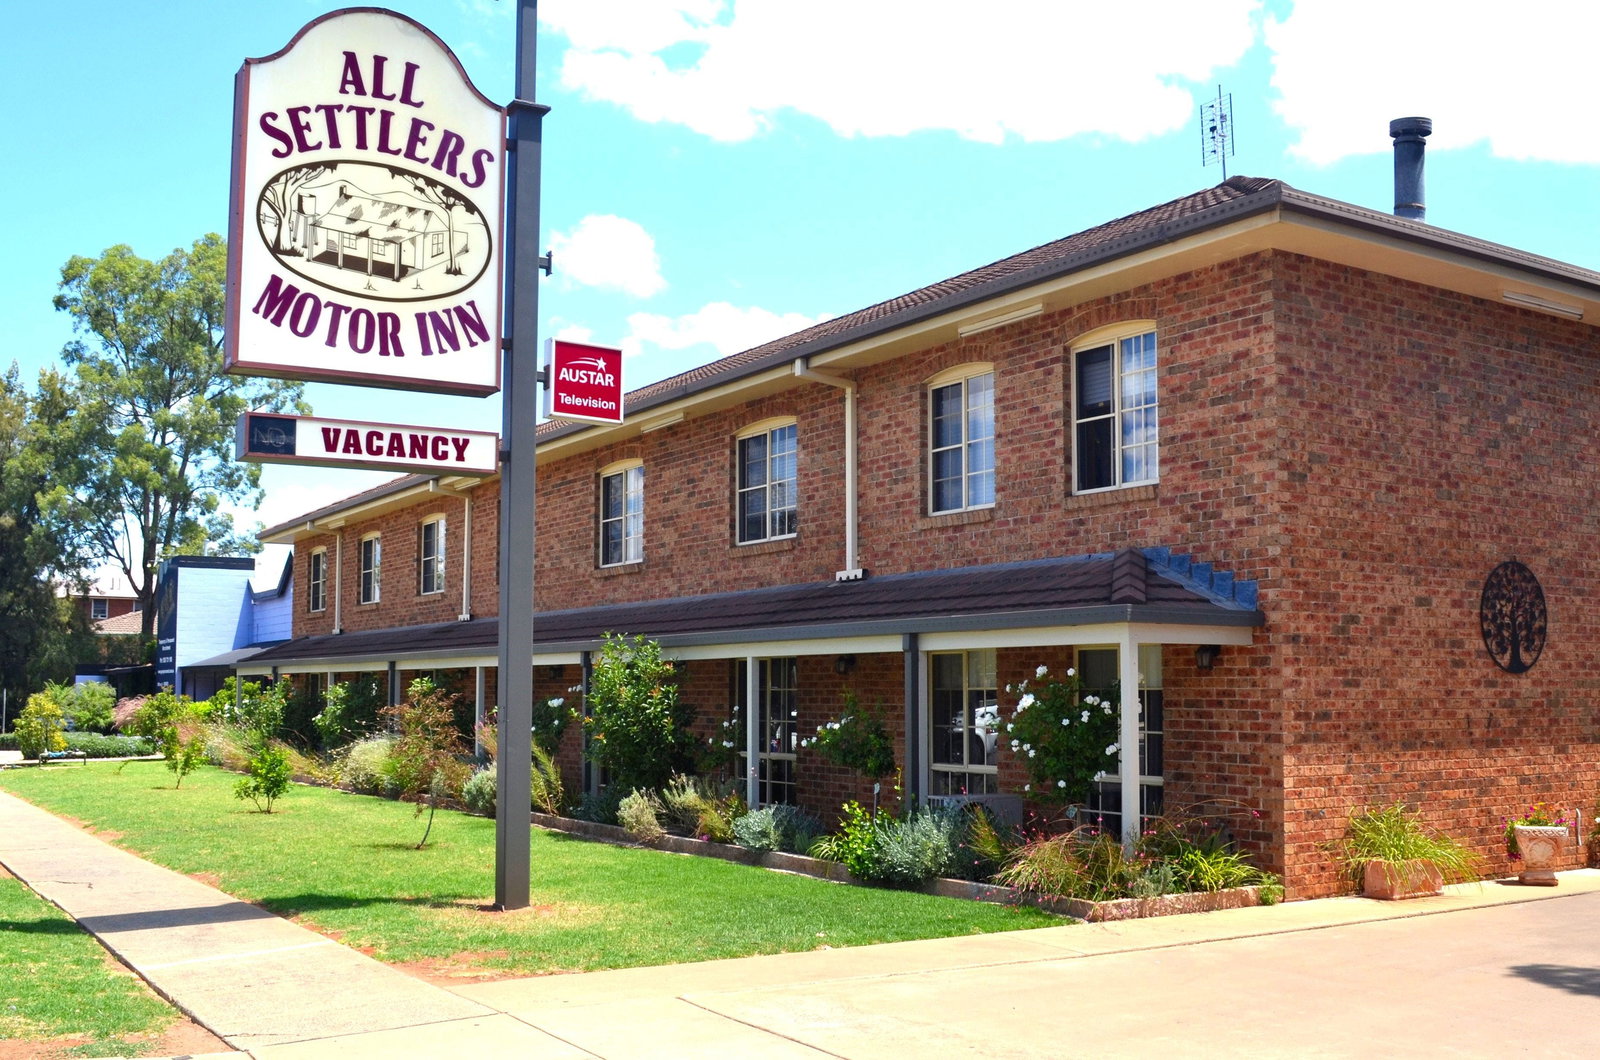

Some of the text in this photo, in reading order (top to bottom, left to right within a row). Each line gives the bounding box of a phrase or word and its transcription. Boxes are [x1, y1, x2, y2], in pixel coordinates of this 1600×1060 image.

[338, 51, 424, 107] ALL
[259, 104, 494, 188] SETTLERS
[252, 274, 490, 357] MOTOR INN
[558, 367, 615, 387] AUSTAR
[558, 392, 616, 410] Television
[321, 427, 470, 462] VACANCY
